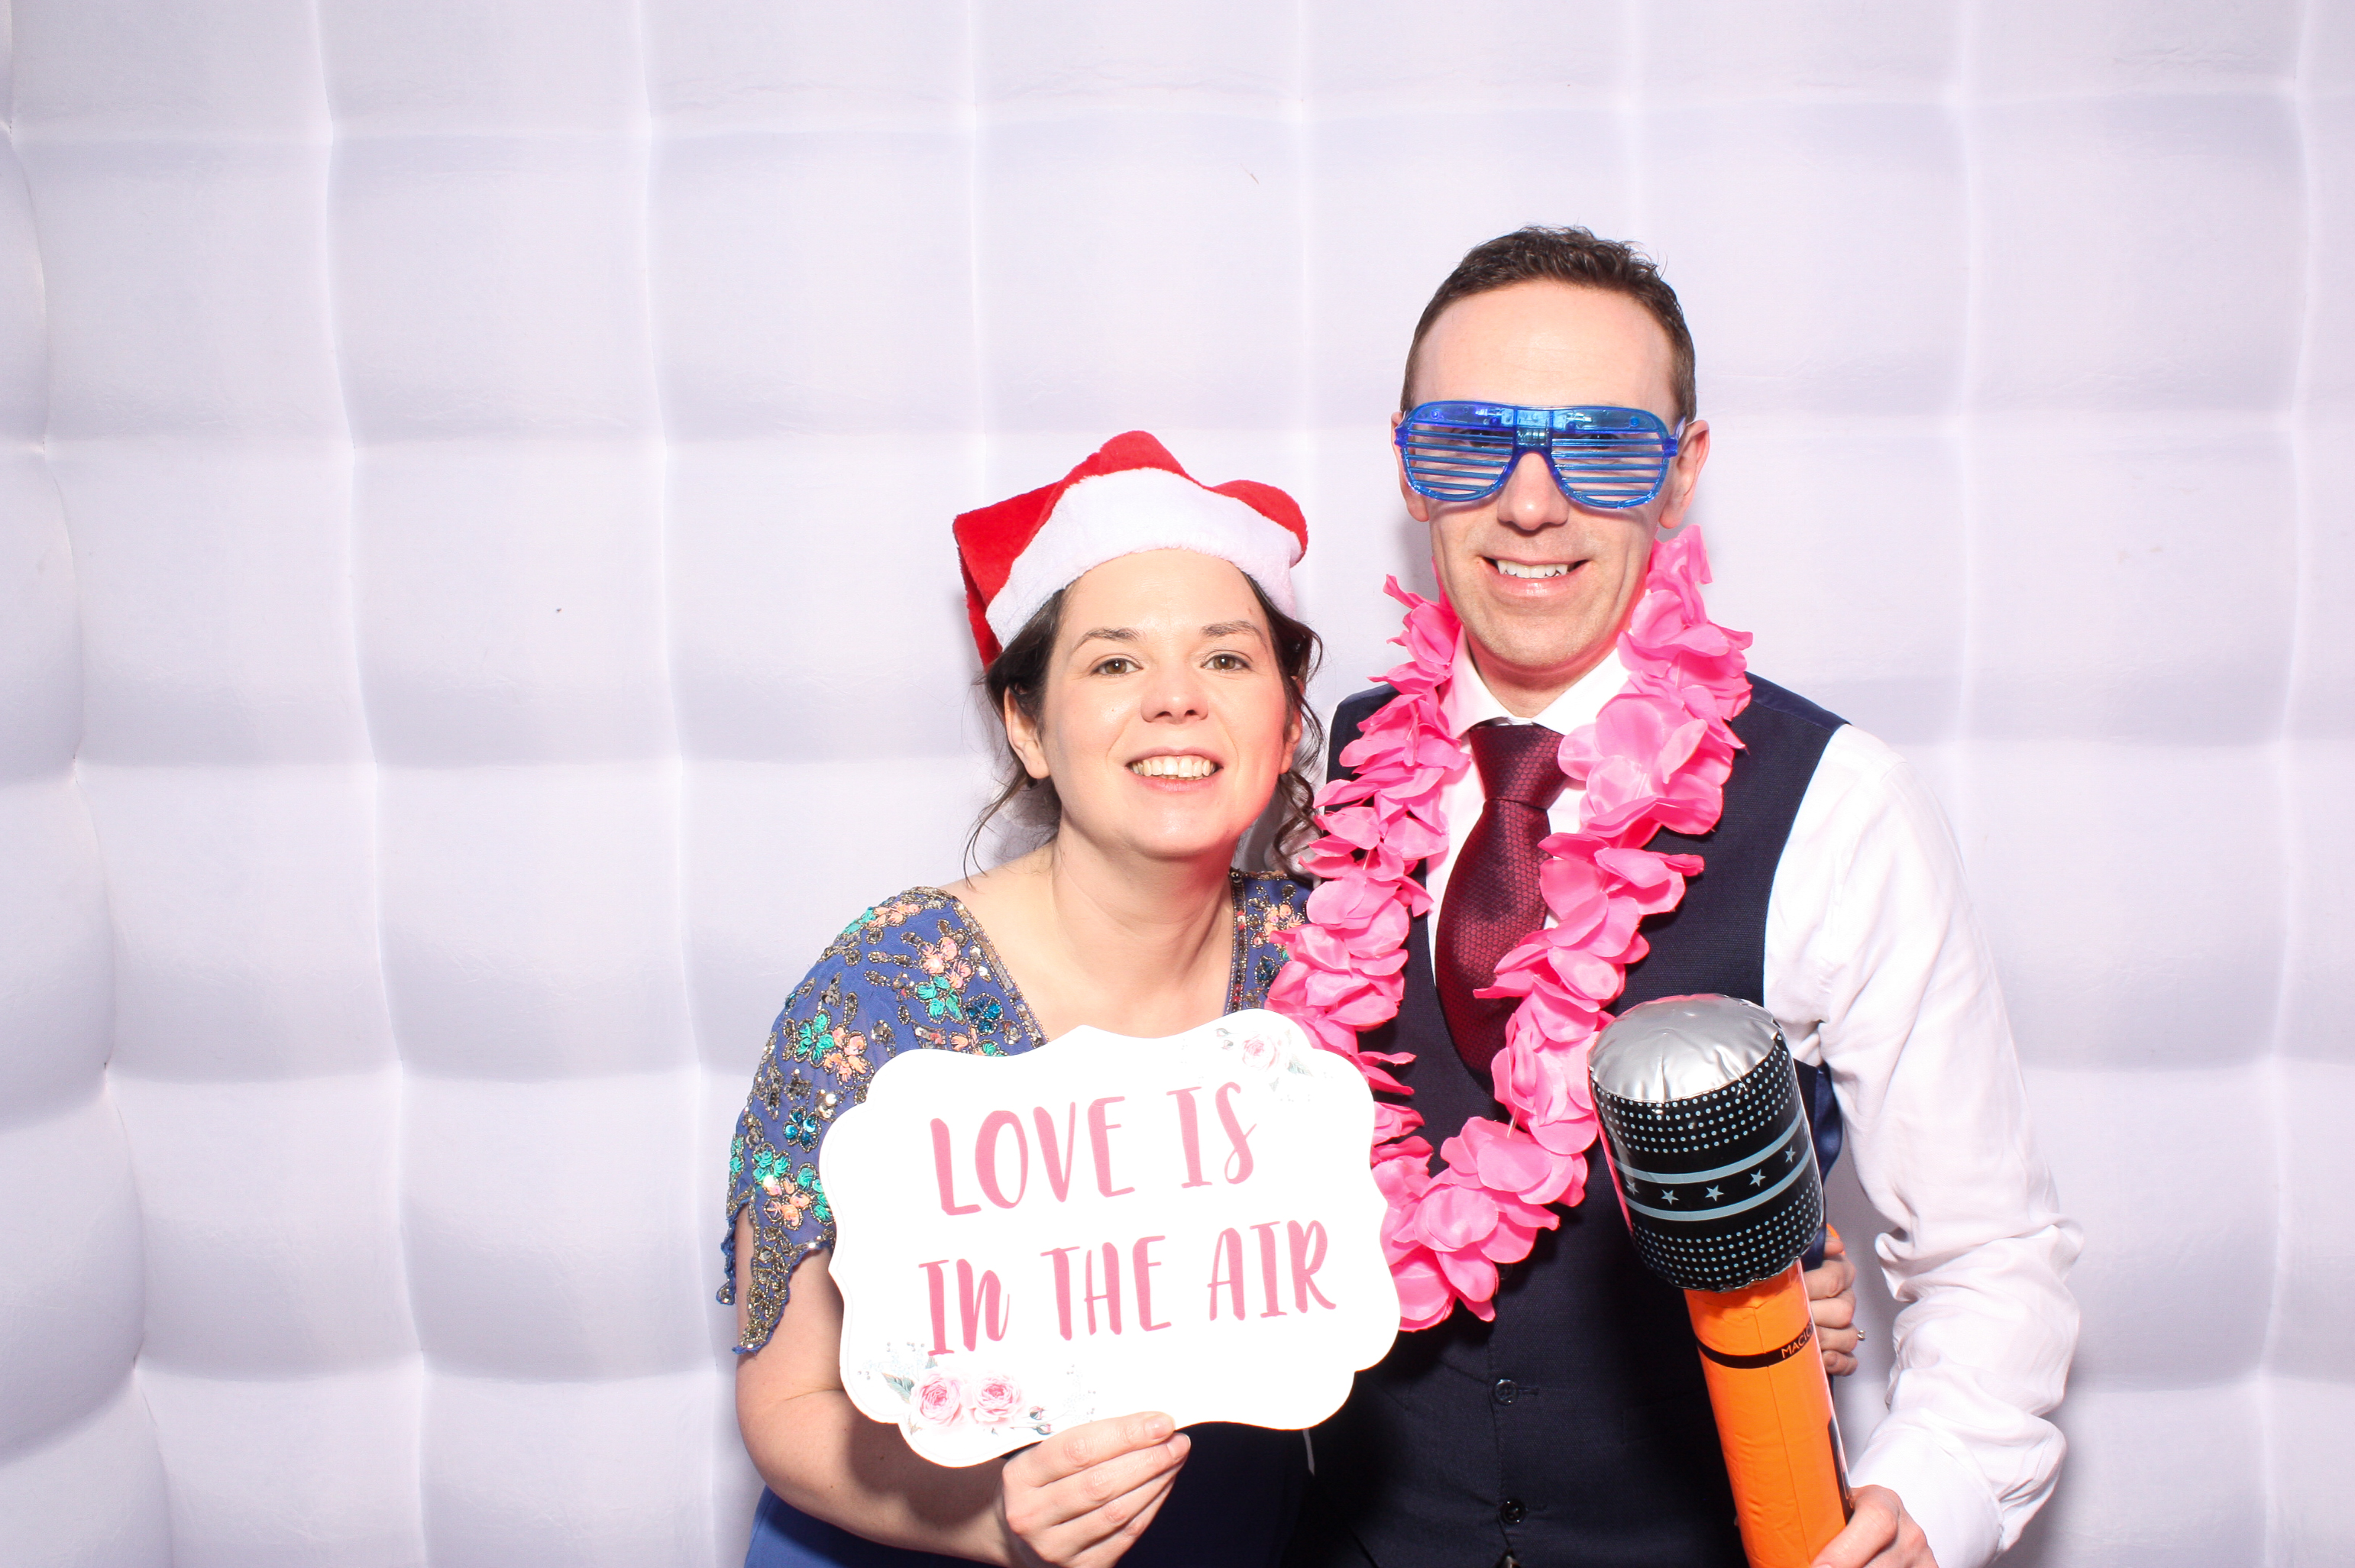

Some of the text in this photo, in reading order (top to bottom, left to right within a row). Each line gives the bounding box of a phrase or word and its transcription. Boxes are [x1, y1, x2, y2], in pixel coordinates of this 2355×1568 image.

[930, 1081, 1257, 1216] LOVE IS
[1040, 1235, 1173, 1340] THE
[1207, 1220, 1337, 1322] AIR
